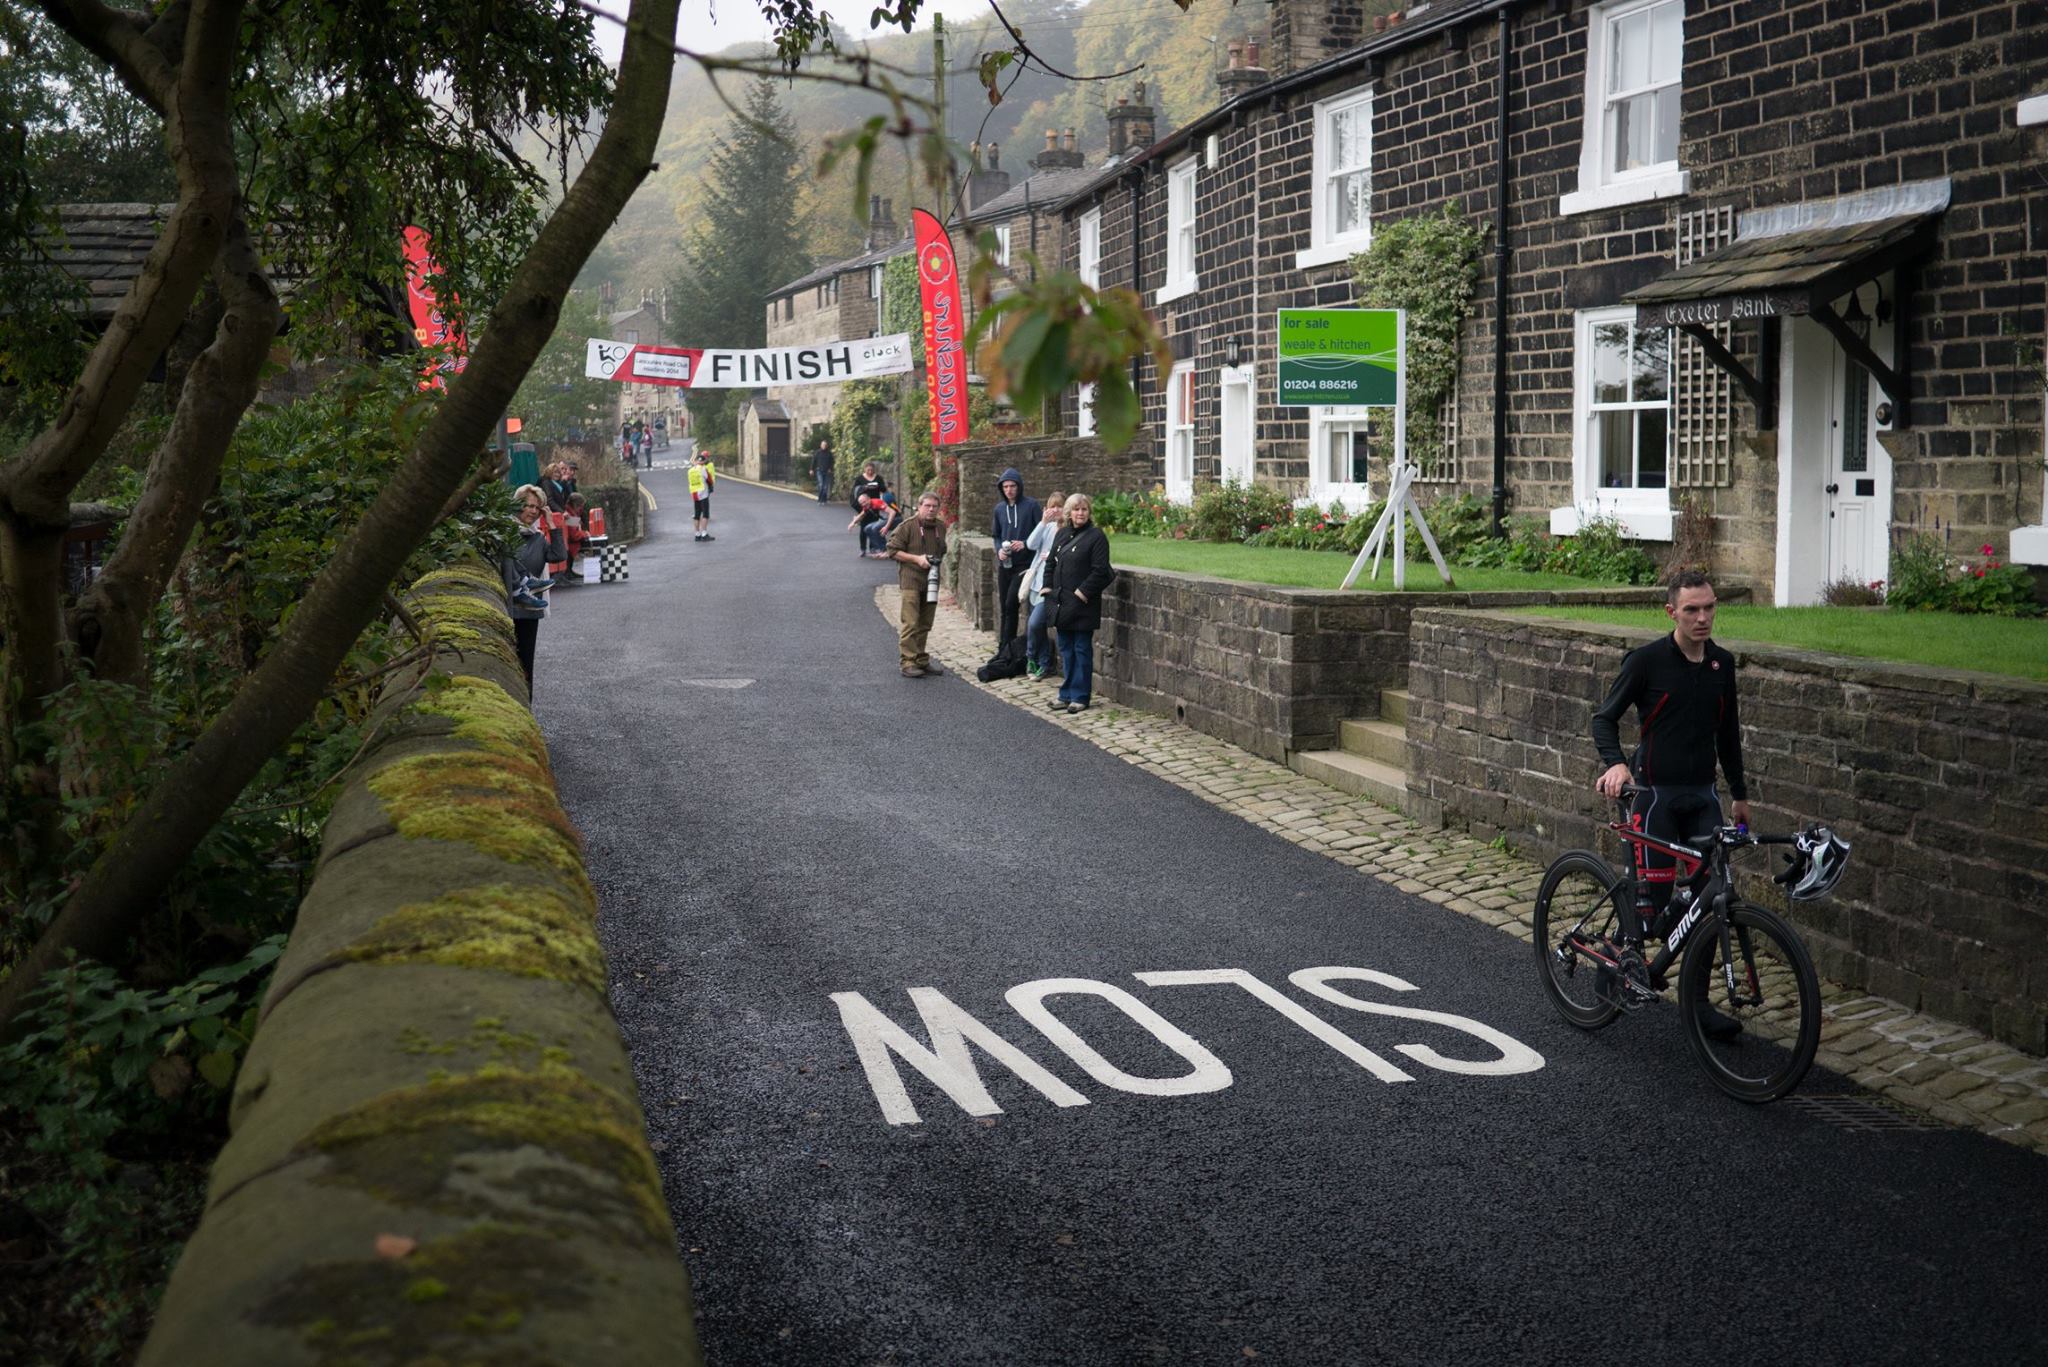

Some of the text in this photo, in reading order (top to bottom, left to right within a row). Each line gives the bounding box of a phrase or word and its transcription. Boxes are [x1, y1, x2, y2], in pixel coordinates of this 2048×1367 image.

[1284, 318, 1330, 328] for sale
[1664, 295, 1775, 325] Exeter Bank
[1284, 339, 1371, 350] weale & hitchen
[712, 347, 852, 382] FINISH
[1283, 380, 1358, 390] 01204 886216
[1667, 896, 1702, 953] BMC
[1726, 963, 1735, 989] BMC
[829, 966, 1546, 1127] SLOW
